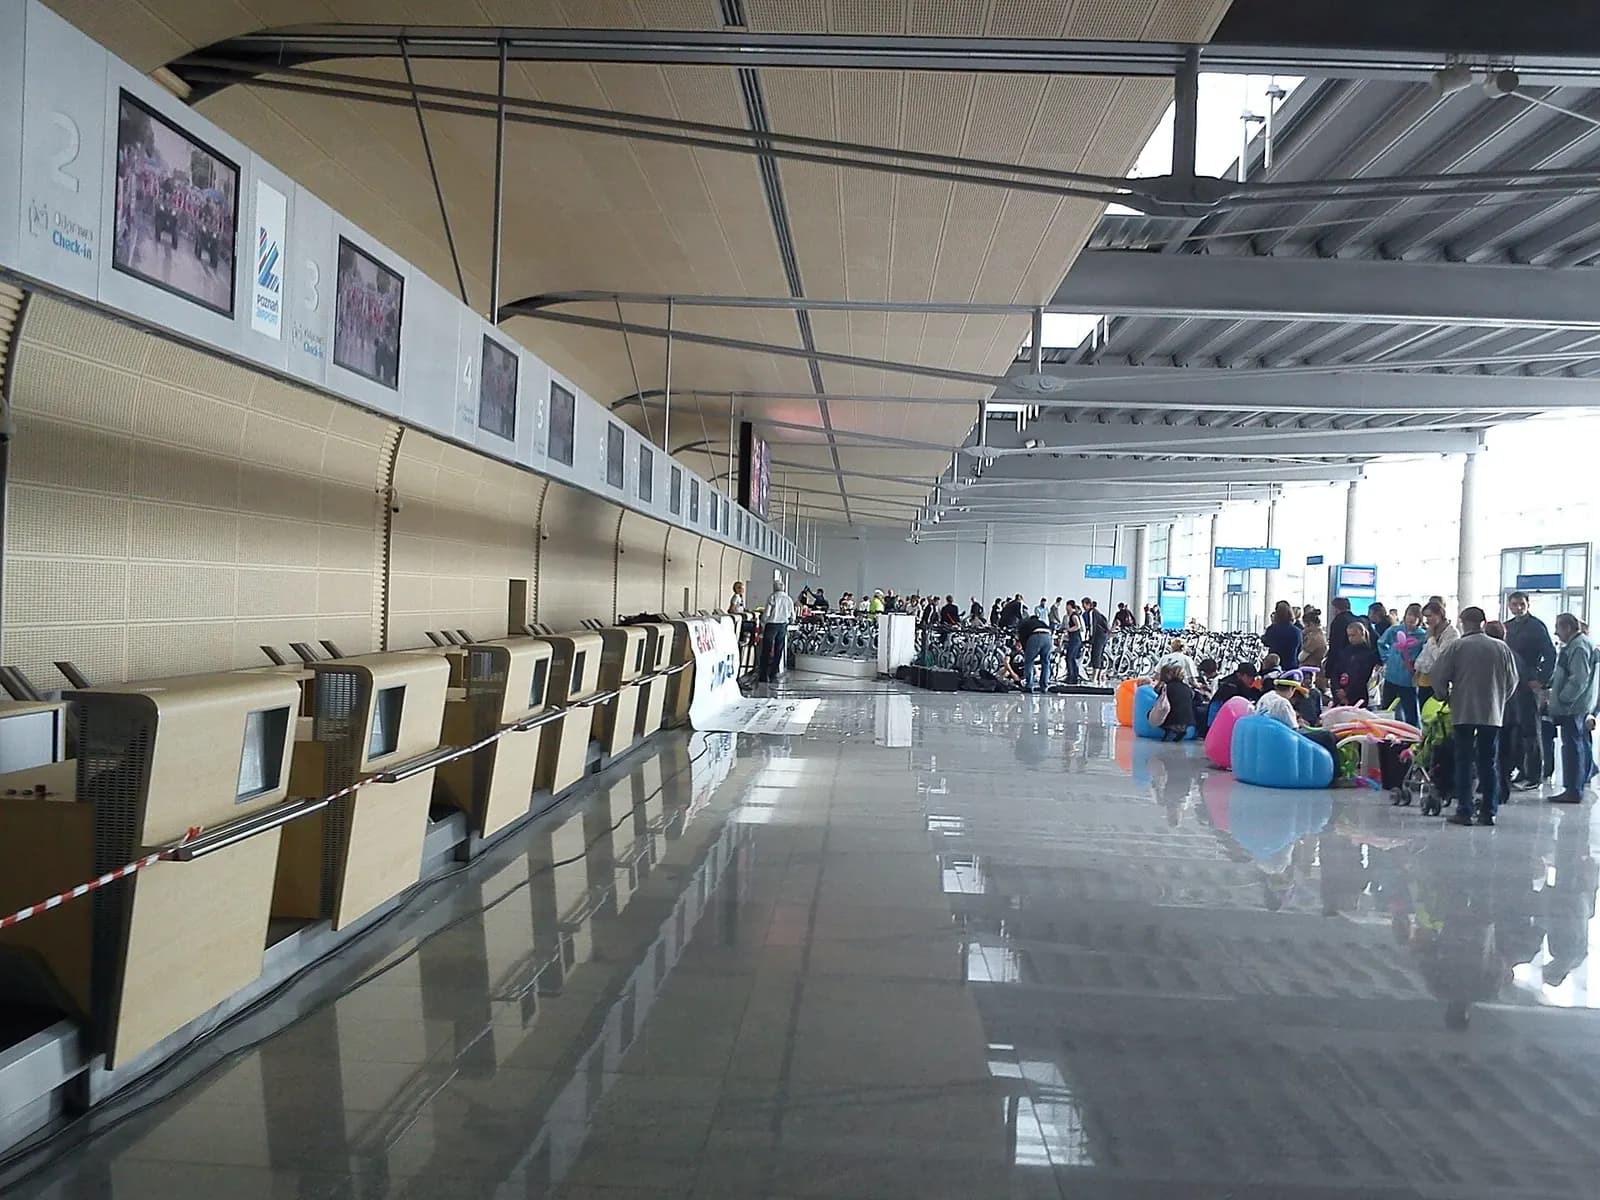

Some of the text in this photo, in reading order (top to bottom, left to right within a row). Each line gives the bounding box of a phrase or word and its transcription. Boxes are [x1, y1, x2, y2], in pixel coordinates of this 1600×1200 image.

[49, 111, 80, 192] 2
[52, 229, 92, 260] Check-in
[304, 259, 320, 312] 3
[463, 356, 473, 392] 4
